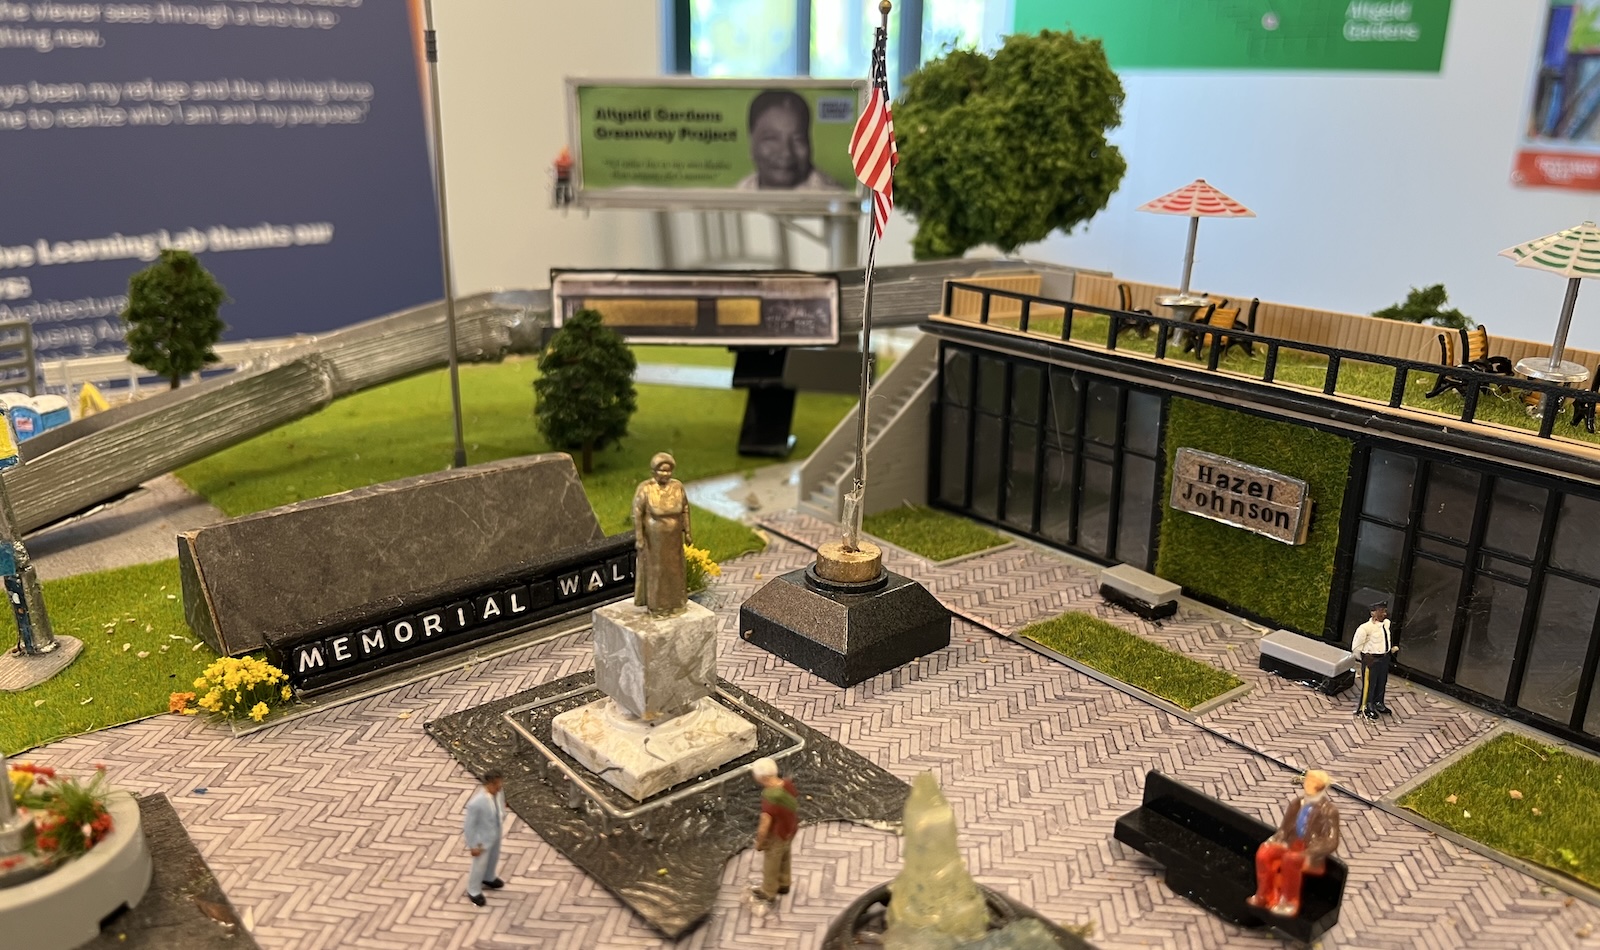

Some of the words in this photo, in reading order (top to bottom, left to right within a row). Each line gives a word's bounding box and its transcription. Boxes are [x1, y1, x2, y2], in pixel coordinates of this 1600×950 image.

[102, 3, 154, 24] sees
[154, 2, 234, 29] through
[28, 80, 86, 103] been
[27, 107, 54, 130] to
[55, 105, 128, 128] realize
[128, 103, 173, 126] who
[36, 232, 161, 265] Learning
[207, 223, 294, 252] thanks
[1198, 464, 1274, 501] Hazel
[1182, 483, 1290, 529] Johnson
[298, 593, 526, 672] MEMORIAL
[559, 563, 634, 596] WAL
